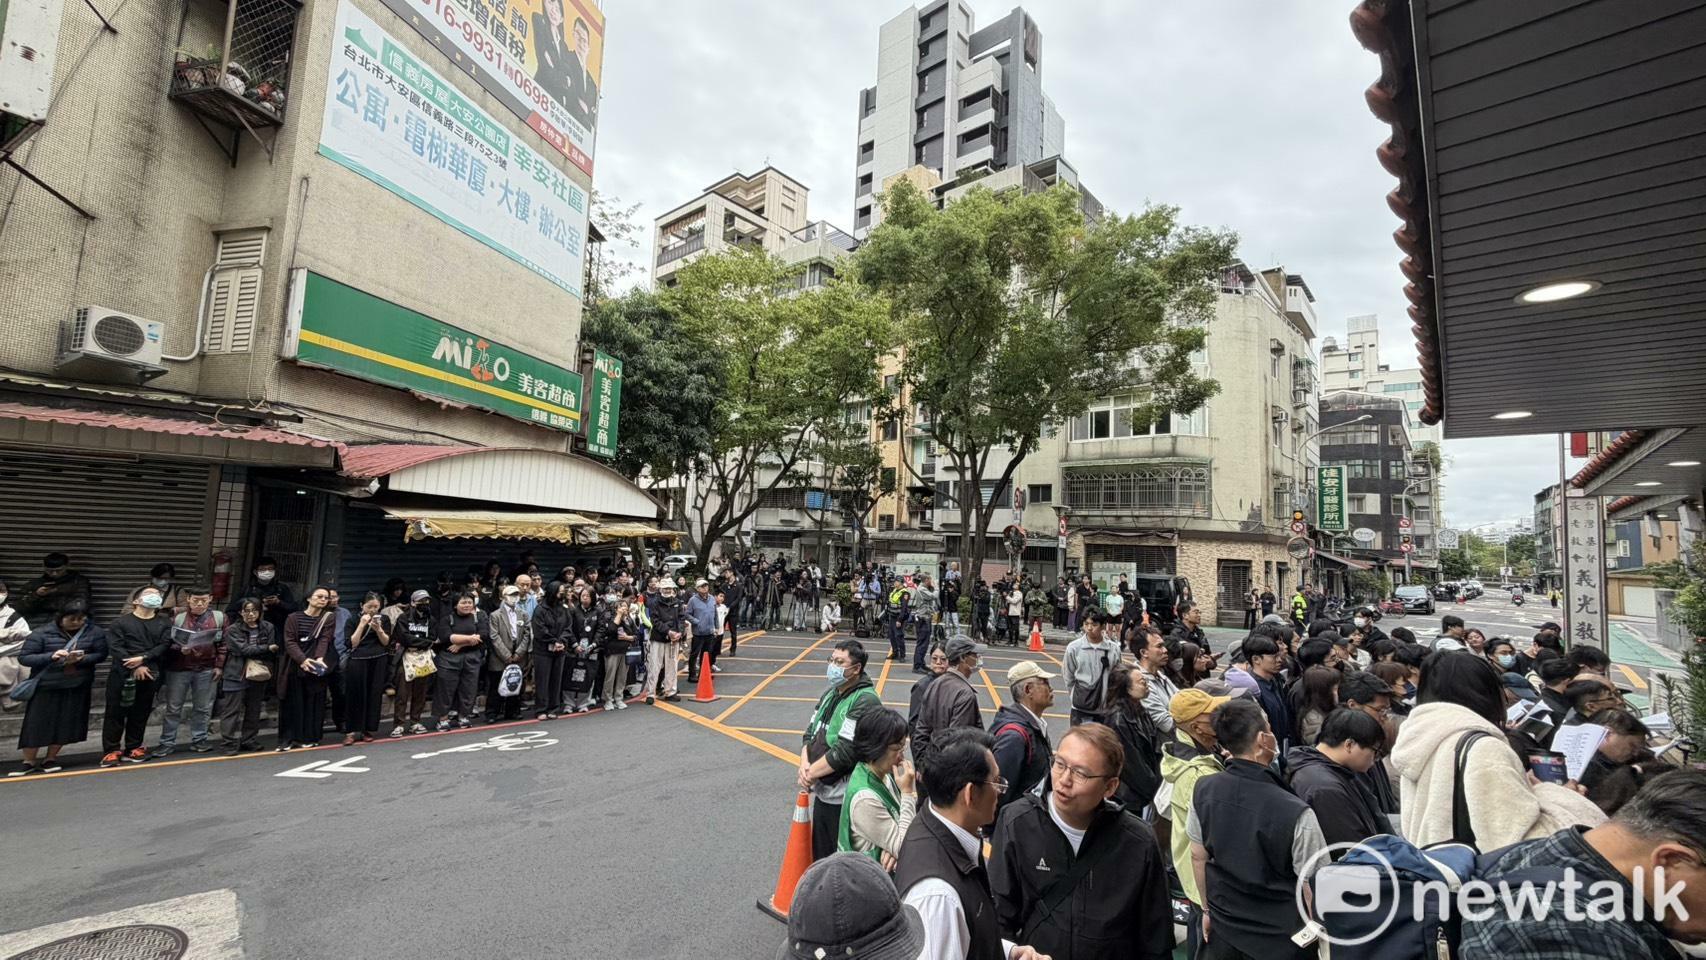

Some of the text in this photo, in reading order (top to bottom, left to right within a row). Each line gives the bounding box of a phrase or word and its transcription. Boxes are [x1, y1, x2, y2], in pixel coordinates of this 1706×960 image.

[388, 49, 450, 113] 信義房屋
[513, 143, 584, 215] 幸安社區
[518, 372, 576, 409] 美客超商
[597, 378, 612, 446] 美客超商
